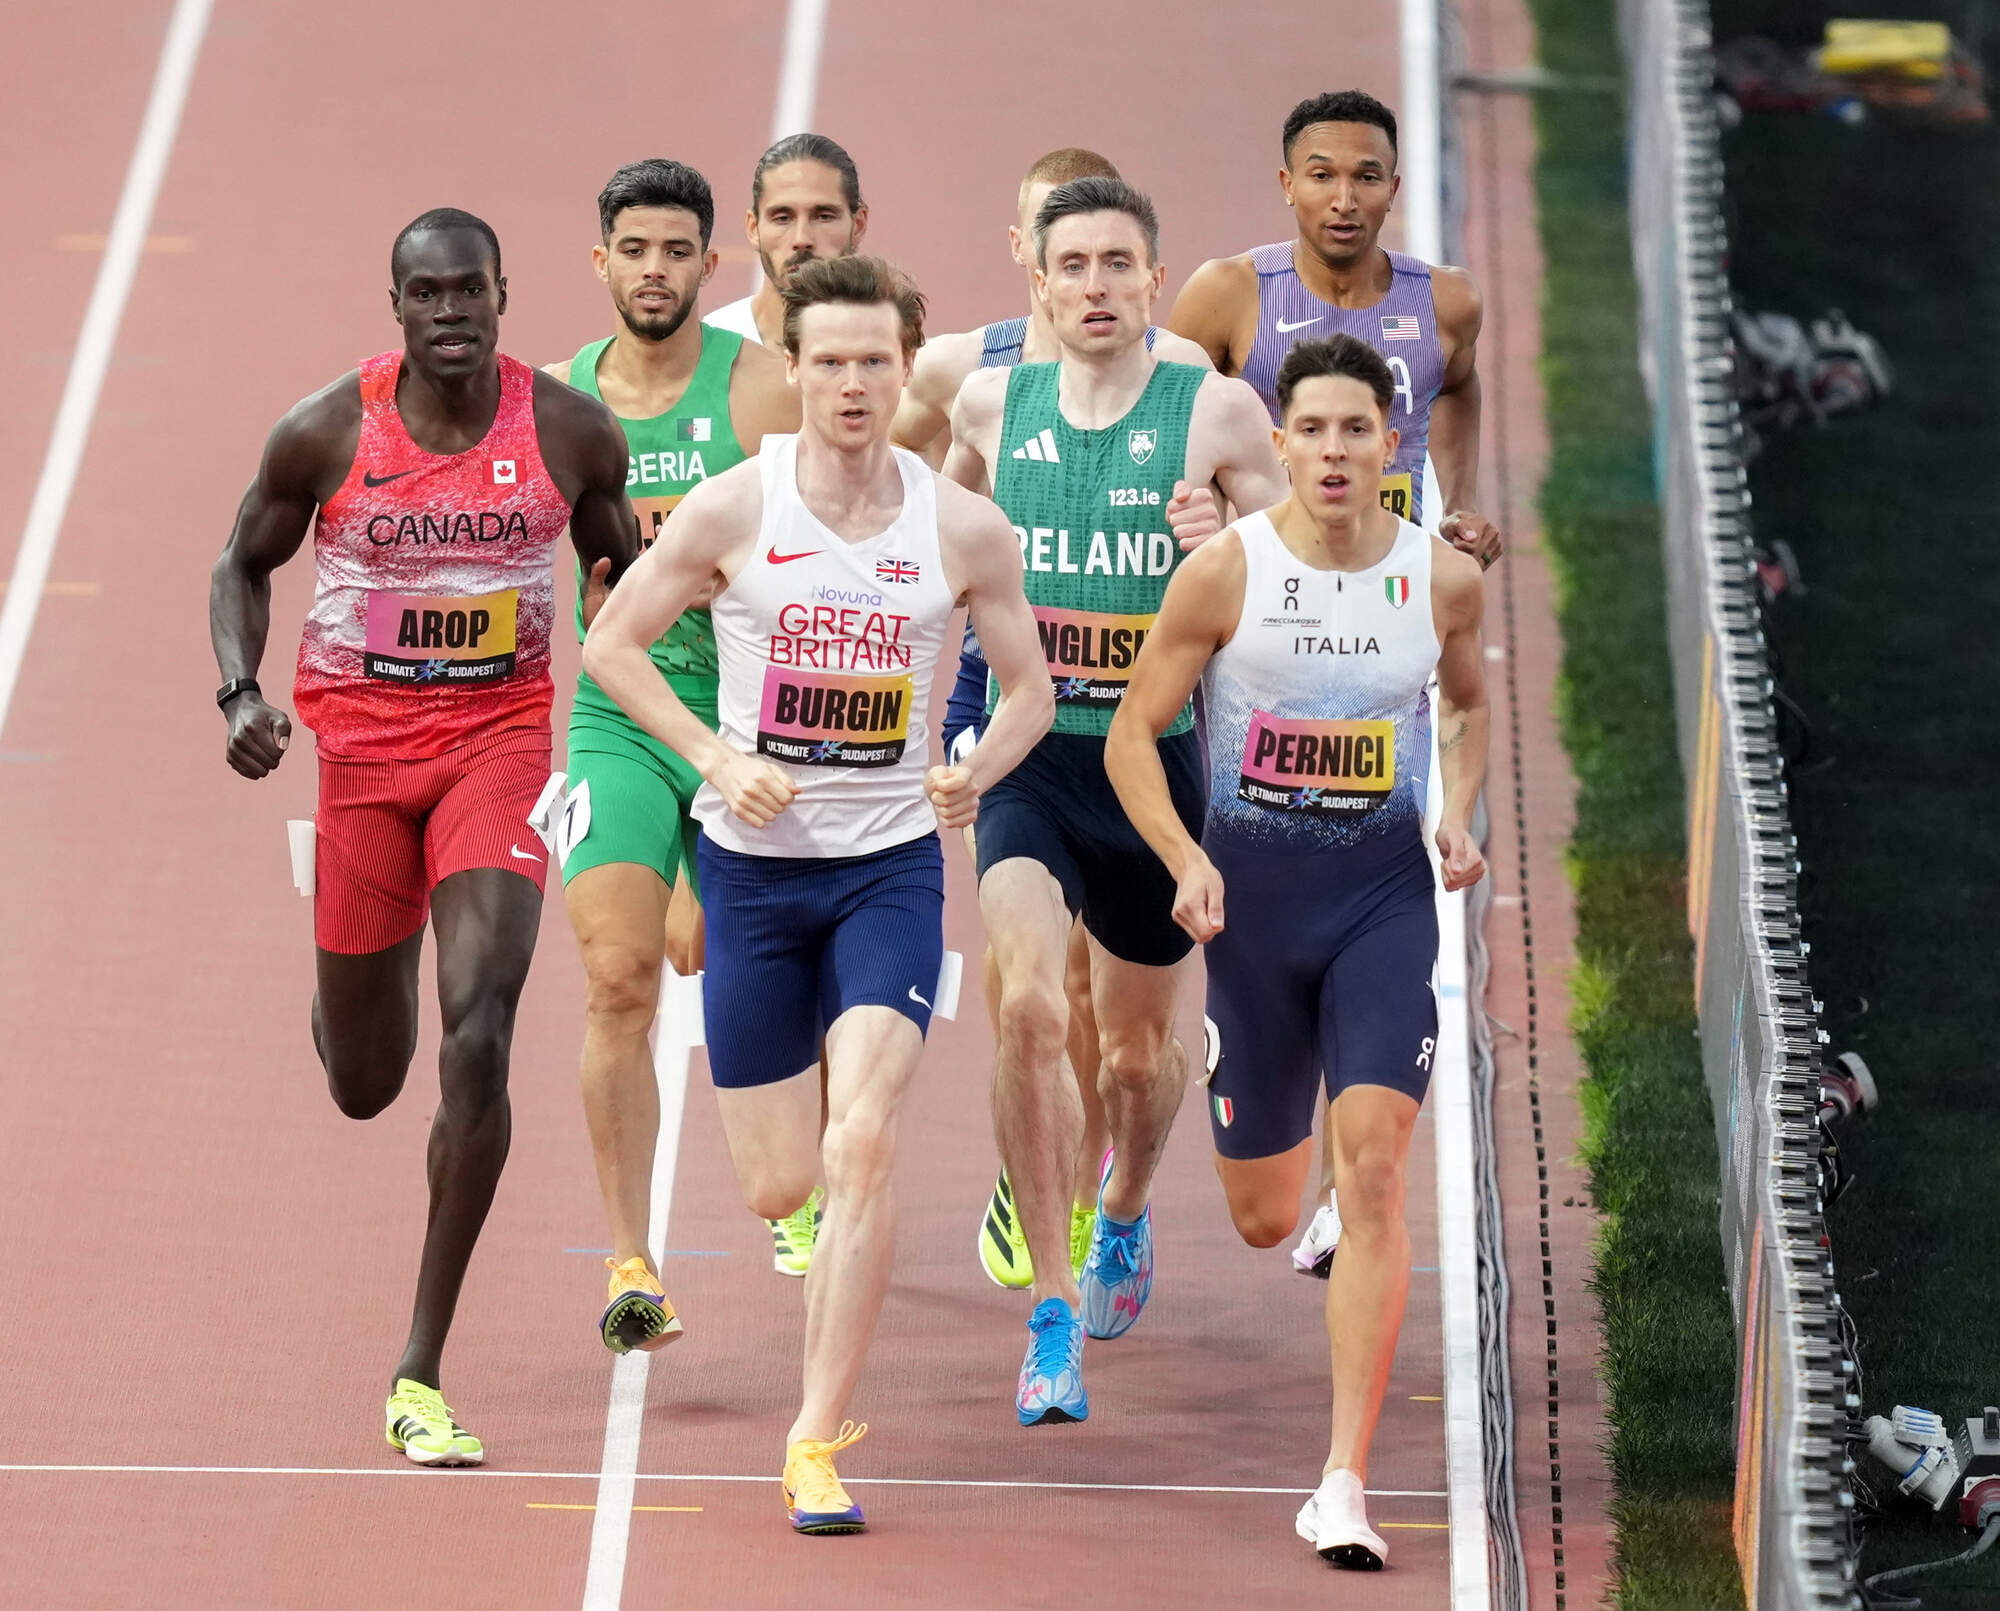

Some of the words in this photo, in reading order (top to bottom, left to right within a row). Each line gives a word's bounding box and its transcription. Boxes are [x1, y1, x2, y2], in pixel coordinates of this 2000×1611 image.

[625, 450, 709, 486] GERIA
[1108, 487, 1160, 506] 123.ie
[367, 511, 528, 546] CANADA
[1011, 525, 1174, 576] RELAND
[811, 584, 882, 606] Novuna
[397, 608, 490, 649] AROP
[778, 603, 911, 644] GREAT
[769, 634, 911, 669] BRITAIN
[1037, 620, 1149, 669] NGLIS
[1294, 636, 1381, 655] ITALIA
[373, 660, 416, 677] ULTIMATE
[448, 663, 495, 678] BUDAPEST
[774, 682, 904, 732] BURGIN
[1089, 686, 1127, 699] BUDAPE
[766, 740, 810, 758] ULTIMATE
[840, 748, 887, 761] BUDAPEST
[1252, 726, 1385, 778] PERNICI
[1248, 784, 1290, 805] ULTIMATE
[1321, 795, 1370, 810] BUDAPEST
